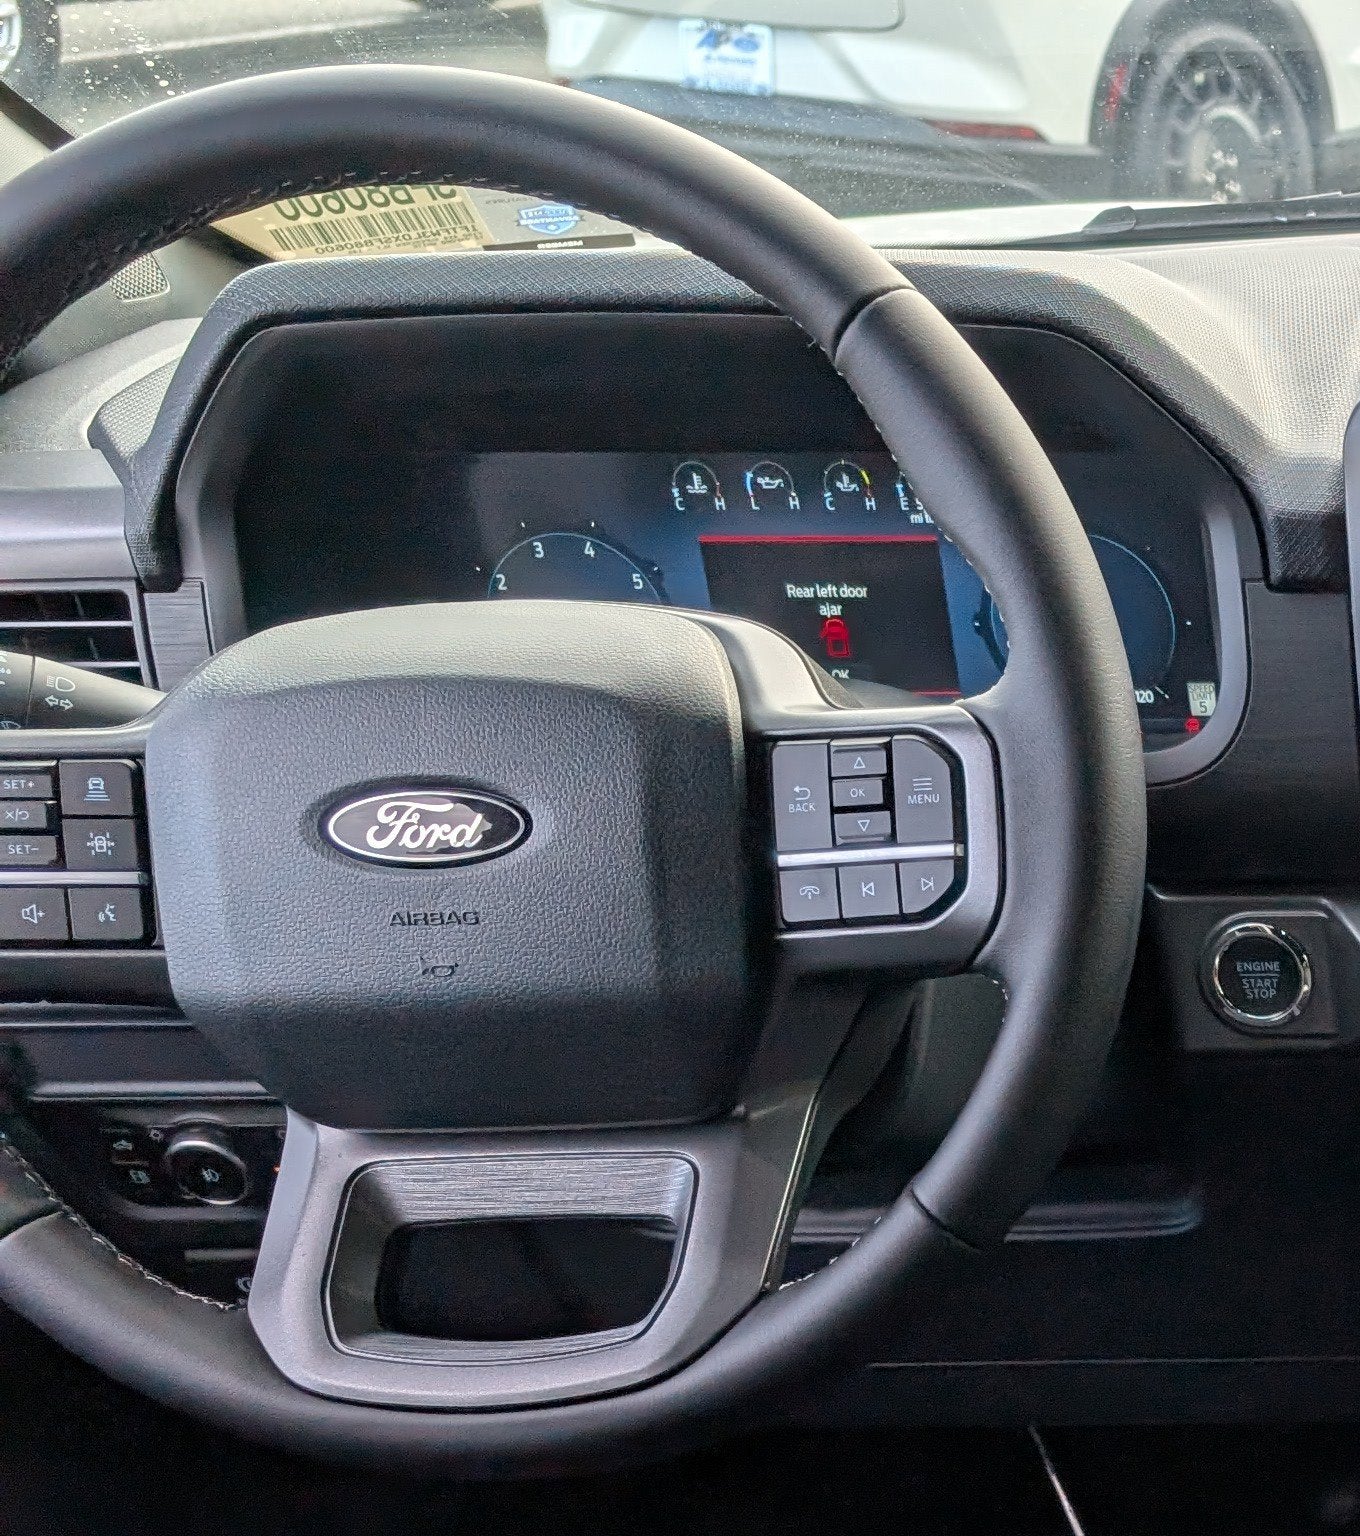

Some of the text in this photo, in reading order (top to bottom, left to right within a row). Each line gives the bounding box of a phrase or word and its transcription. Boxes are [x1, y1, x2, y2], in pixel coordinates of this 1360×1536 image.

[533, 541, 544, 558] 3
[584, 541, 595, 558] 4
[495, 574, 508, 591] 2
[632, 573, 643, 590] 5
[785, 583, 868, 598] Rear left door
[819, 602, 843, 618] ajar
[1199, 700, 1208, 714] 5
[850, 788, 865, 797] OK
[908, 793, 940, 805] MENU
[788, 802, 816, 813] BACK
[366, 801, 483, 849] Ford
[390, 911, 480, 927] AIRBAG
[1236, 961, 1280, 972] ENGINE
[1242, 978, 1278, 988] START
[1246, 989, 1277, 999] STOP
